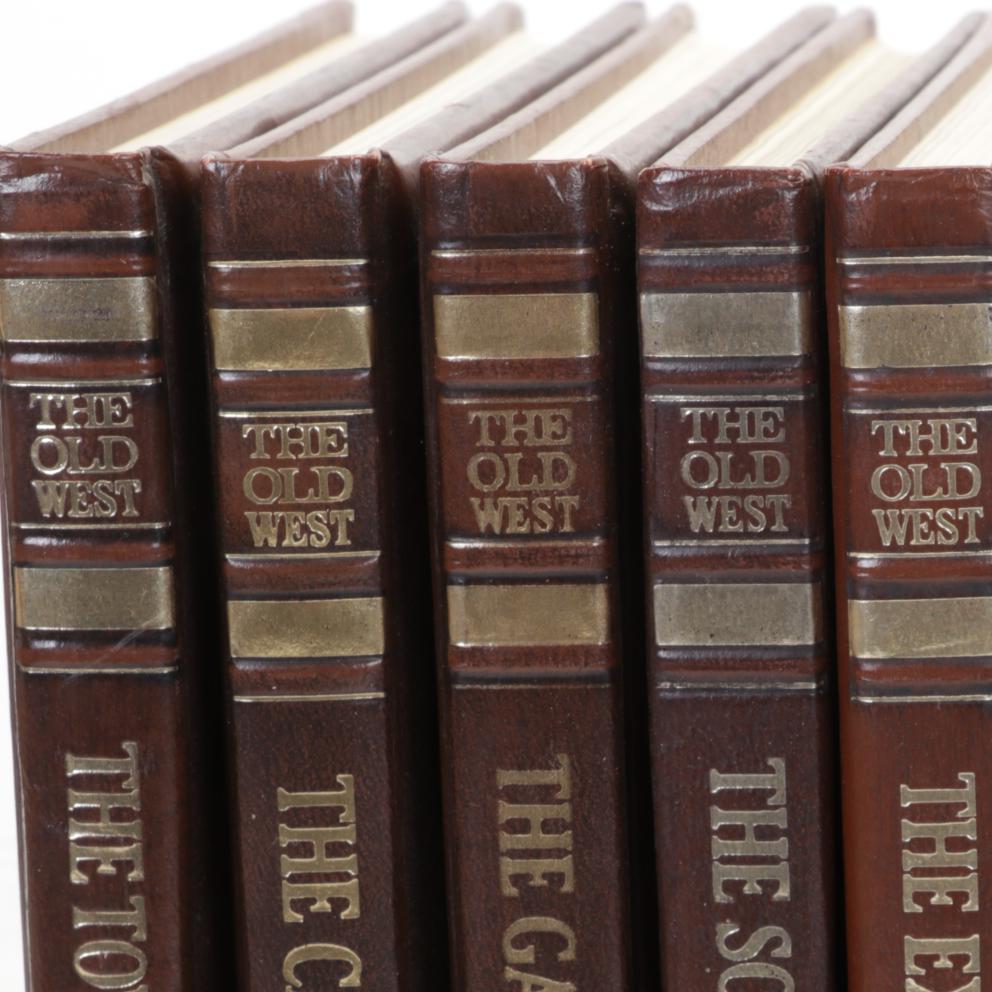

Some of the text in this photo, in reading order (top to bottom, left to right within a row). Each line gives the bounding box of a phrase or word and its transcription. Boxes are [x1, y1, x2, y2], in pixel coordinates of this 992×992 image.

[29, 392, 132, 430] THE
[468, 407, 573, 448] THE
[681, 407, 785, 444] THE
[29, 436, 139, 475] OLD
[242, 422, 349, 460] THE
[872, 418, 978, 457] THE
[242, 465, 354, 504] OLD
[467, 451, 576, 492] OLD
[681, 450, 790, 490] OLD
[871, 463, 982, 501] OLD
[31, 479, 142, 519] WEST
[469, 493, 580, 535] WEST
[685, 494, 793, 533] WEST
[245, 509, 354, 548] WEST
[874, 507, 985, 547] WEST
[65, 741, 145, 884] THE
[496, 754, 574, 896] THE
[709, 758, 791, 902] THE
[277, 773, 360, 922] THE
[900, 772, 979, 913] THE
